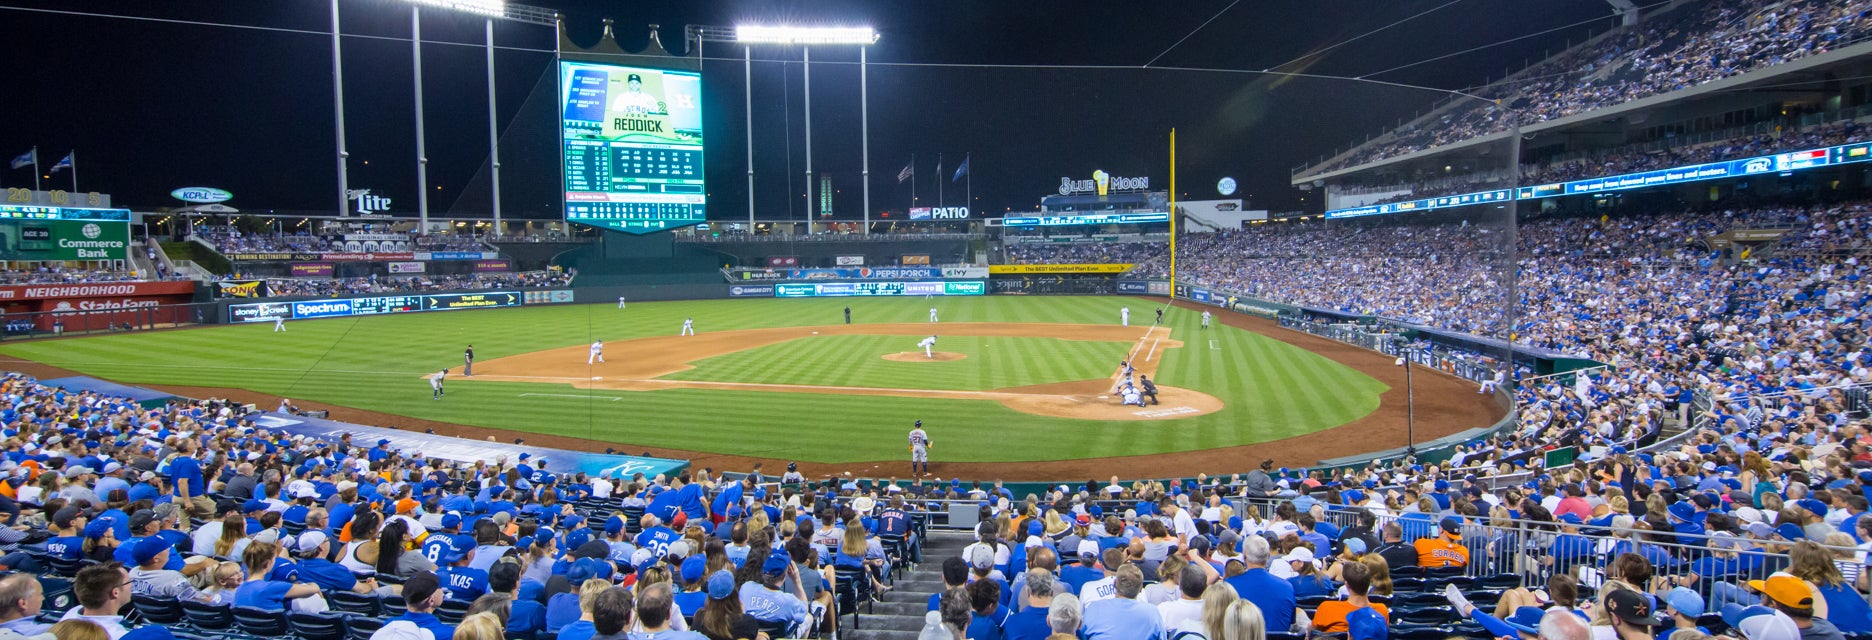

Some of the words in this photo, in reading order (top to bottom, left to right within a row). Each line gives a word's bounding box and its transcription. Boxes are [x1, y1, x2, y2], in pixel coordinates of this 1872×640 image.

[614, 118, 663, 132] REDDICK
[1684, 170, 1698, 178] and
[1059, 177, 1094, 195] BLUE
[1111, 176, 1149, 190] MOON
[7, 187, 31, 203] 20
[47, 190, 67, 205] 10
[88, 191, 100, 206] 5
[182, 191, 209, 200] KCP&L
[357, 193, 392, 214] Lite
[932, 206, 969, 219] PATIO
[58, 238, 123, 248] Commerce
[77, 248, 109, 258] Bank
[875, 269, 899, 277] PEPSI
[901, 269, 930, 277] PORCH
[25, 285, 136, 298] NEIGHBORHOOD
[223, 286, 257, 294] SONIC
[235, 308, 258, 316] stoney
[269, 305, 289, 313] creek
[297, 302, 347, 316] Spectrum
[887, 517, 893, 531] 1
[654, 530, 670, 541] SMITH
[47, 543, 67, 553] PEREZ
[427, 543, 441, 563] 8
[1432, 548, 1465, 564] CORREA
[1096, 584, 1117, 598] GOR
[751, 596, 780, 614] PEREZ
